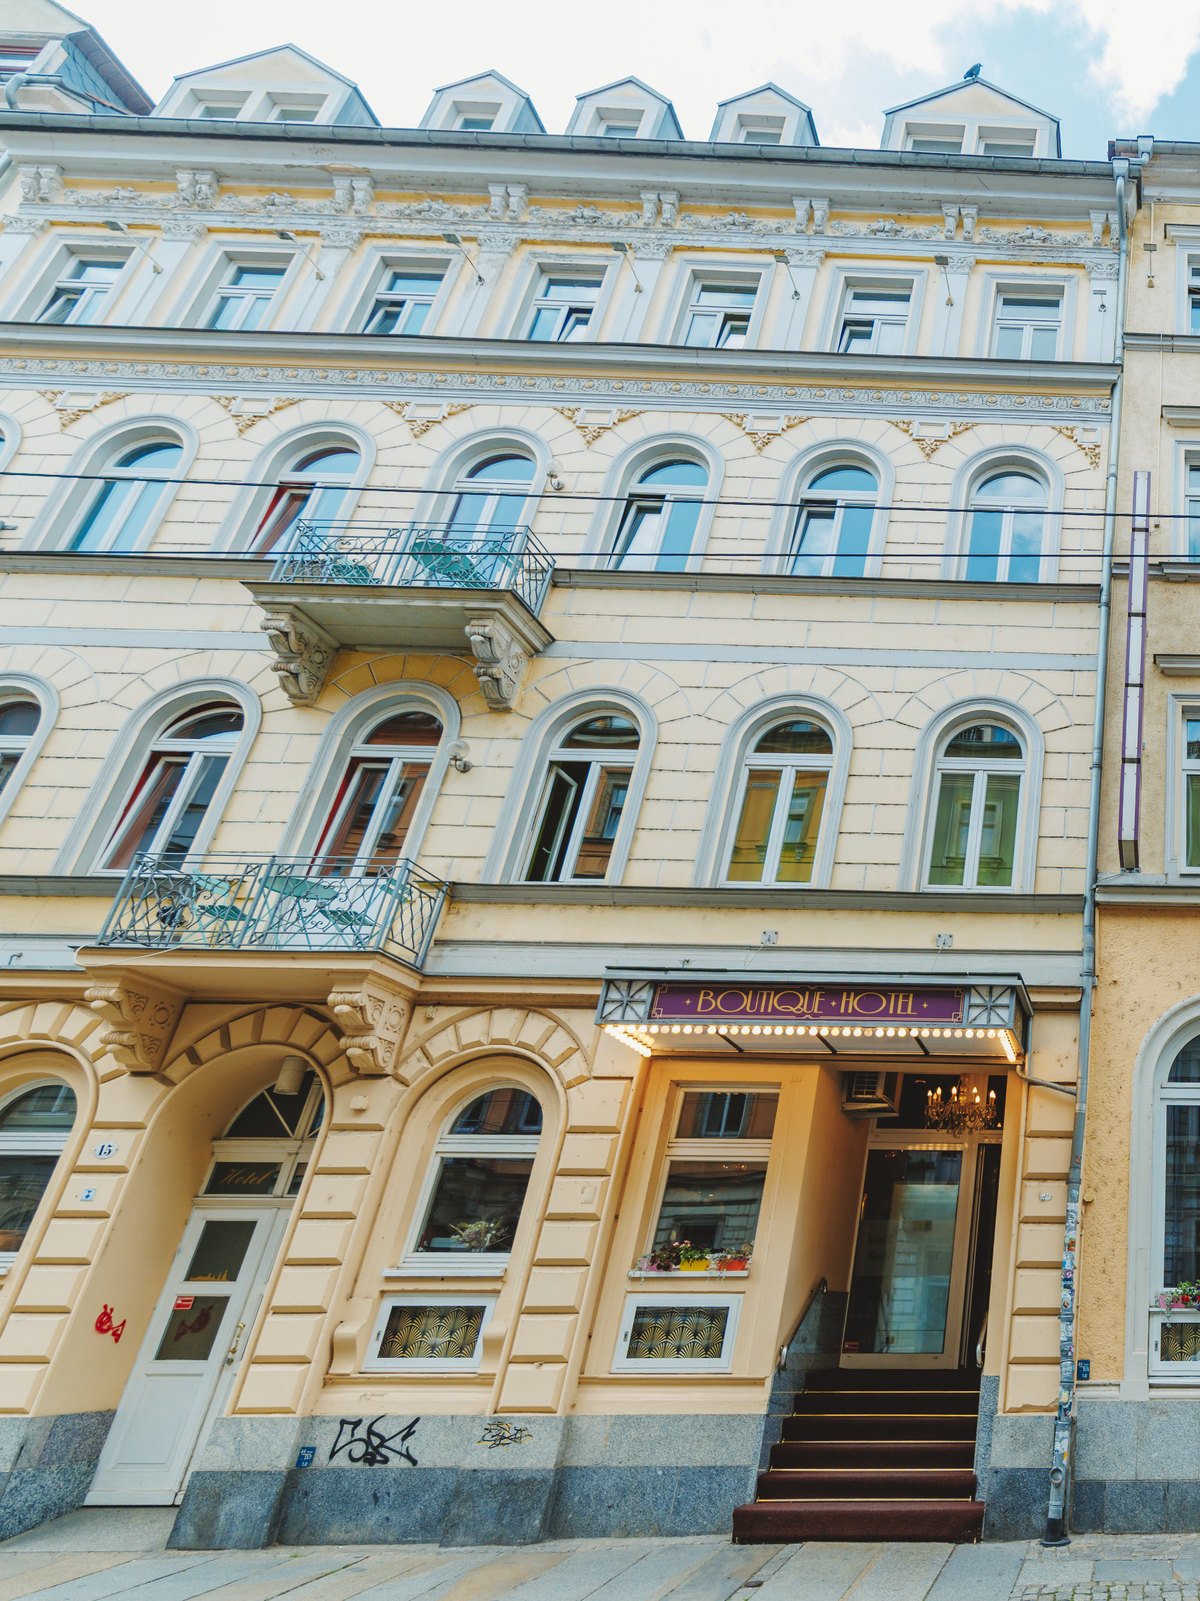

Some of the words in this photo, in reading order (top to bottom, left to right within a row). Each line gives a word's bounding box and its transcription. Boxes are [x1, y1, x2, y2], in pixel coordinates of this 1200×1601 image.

[696, 989, 826, 1014] BOUTIQUE
[839, 991, 918, 1016] HOTEL
[98, 1144, 114, 1157] 15
[219, 1168, 275, 1185] Hotel
